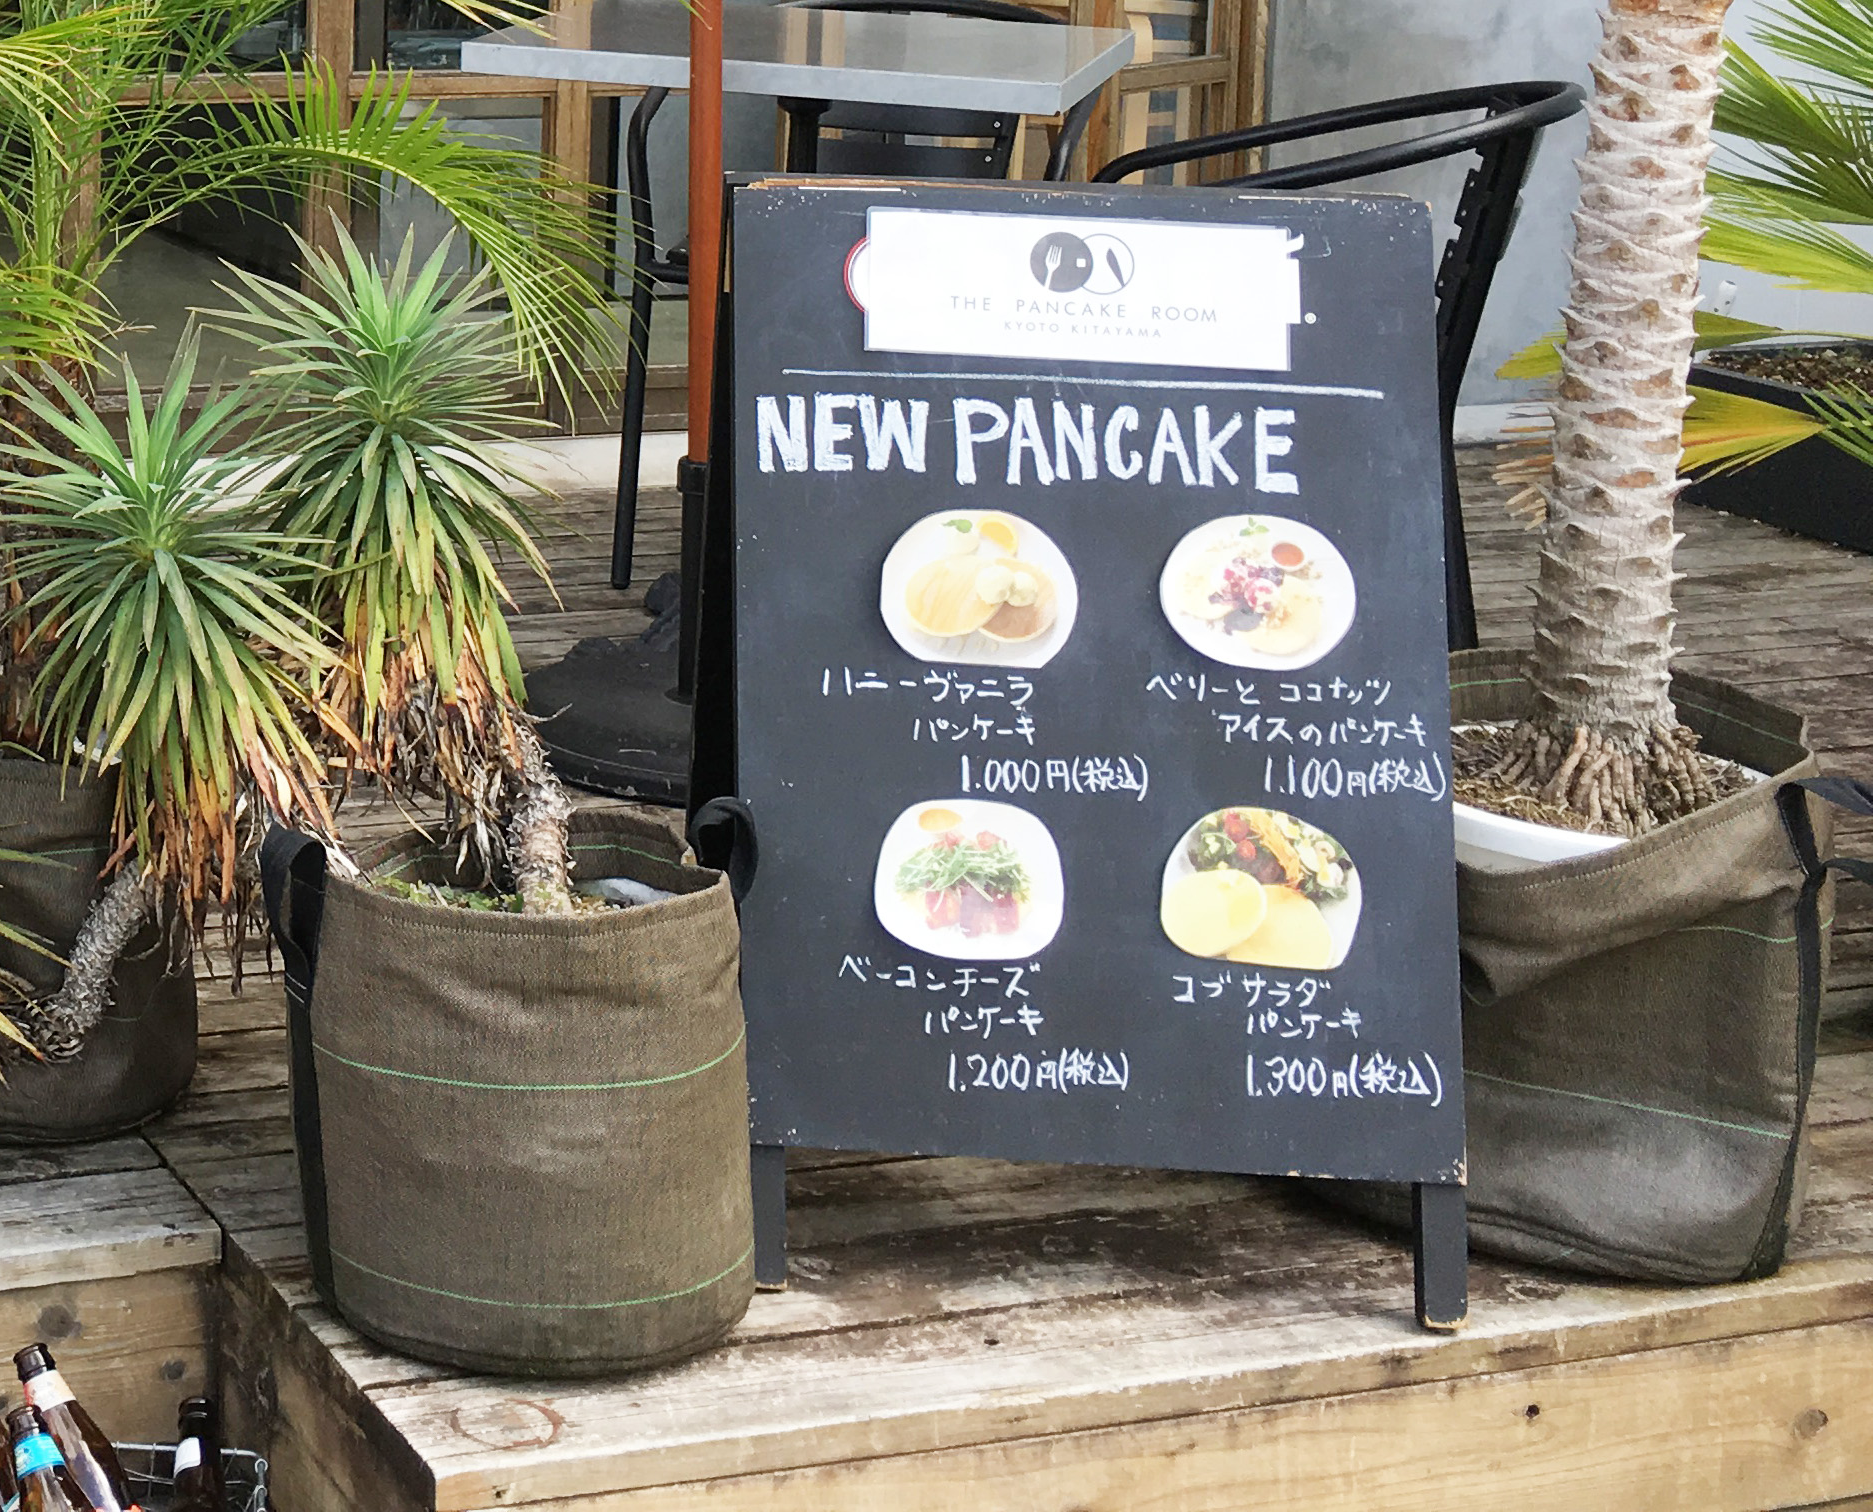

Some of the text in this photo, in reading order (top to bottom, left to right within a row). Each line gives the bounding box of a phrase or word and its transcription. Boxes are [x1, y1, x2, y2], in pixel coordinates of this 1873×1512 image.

[950, 295, 1217, 324] THE PANCAKE ROOM
[1003, 320, 1162, 338] KYOTO KITAYAMA
[755, 392, 1300, 496] NEW PANCAKE
[822, 666, 1033, 705] ハニーヴァニラ
[913, 713, 1035, 745] パンケーキ
[1218, 713, 1426, 747] アイスのパンケーキ
[838, 955, 1041, 998] ベーコンチーズ
[925, 1002, 1044, 1039] パンケーキ
[1247, 1004, 1362, 1039] パンケーキ
